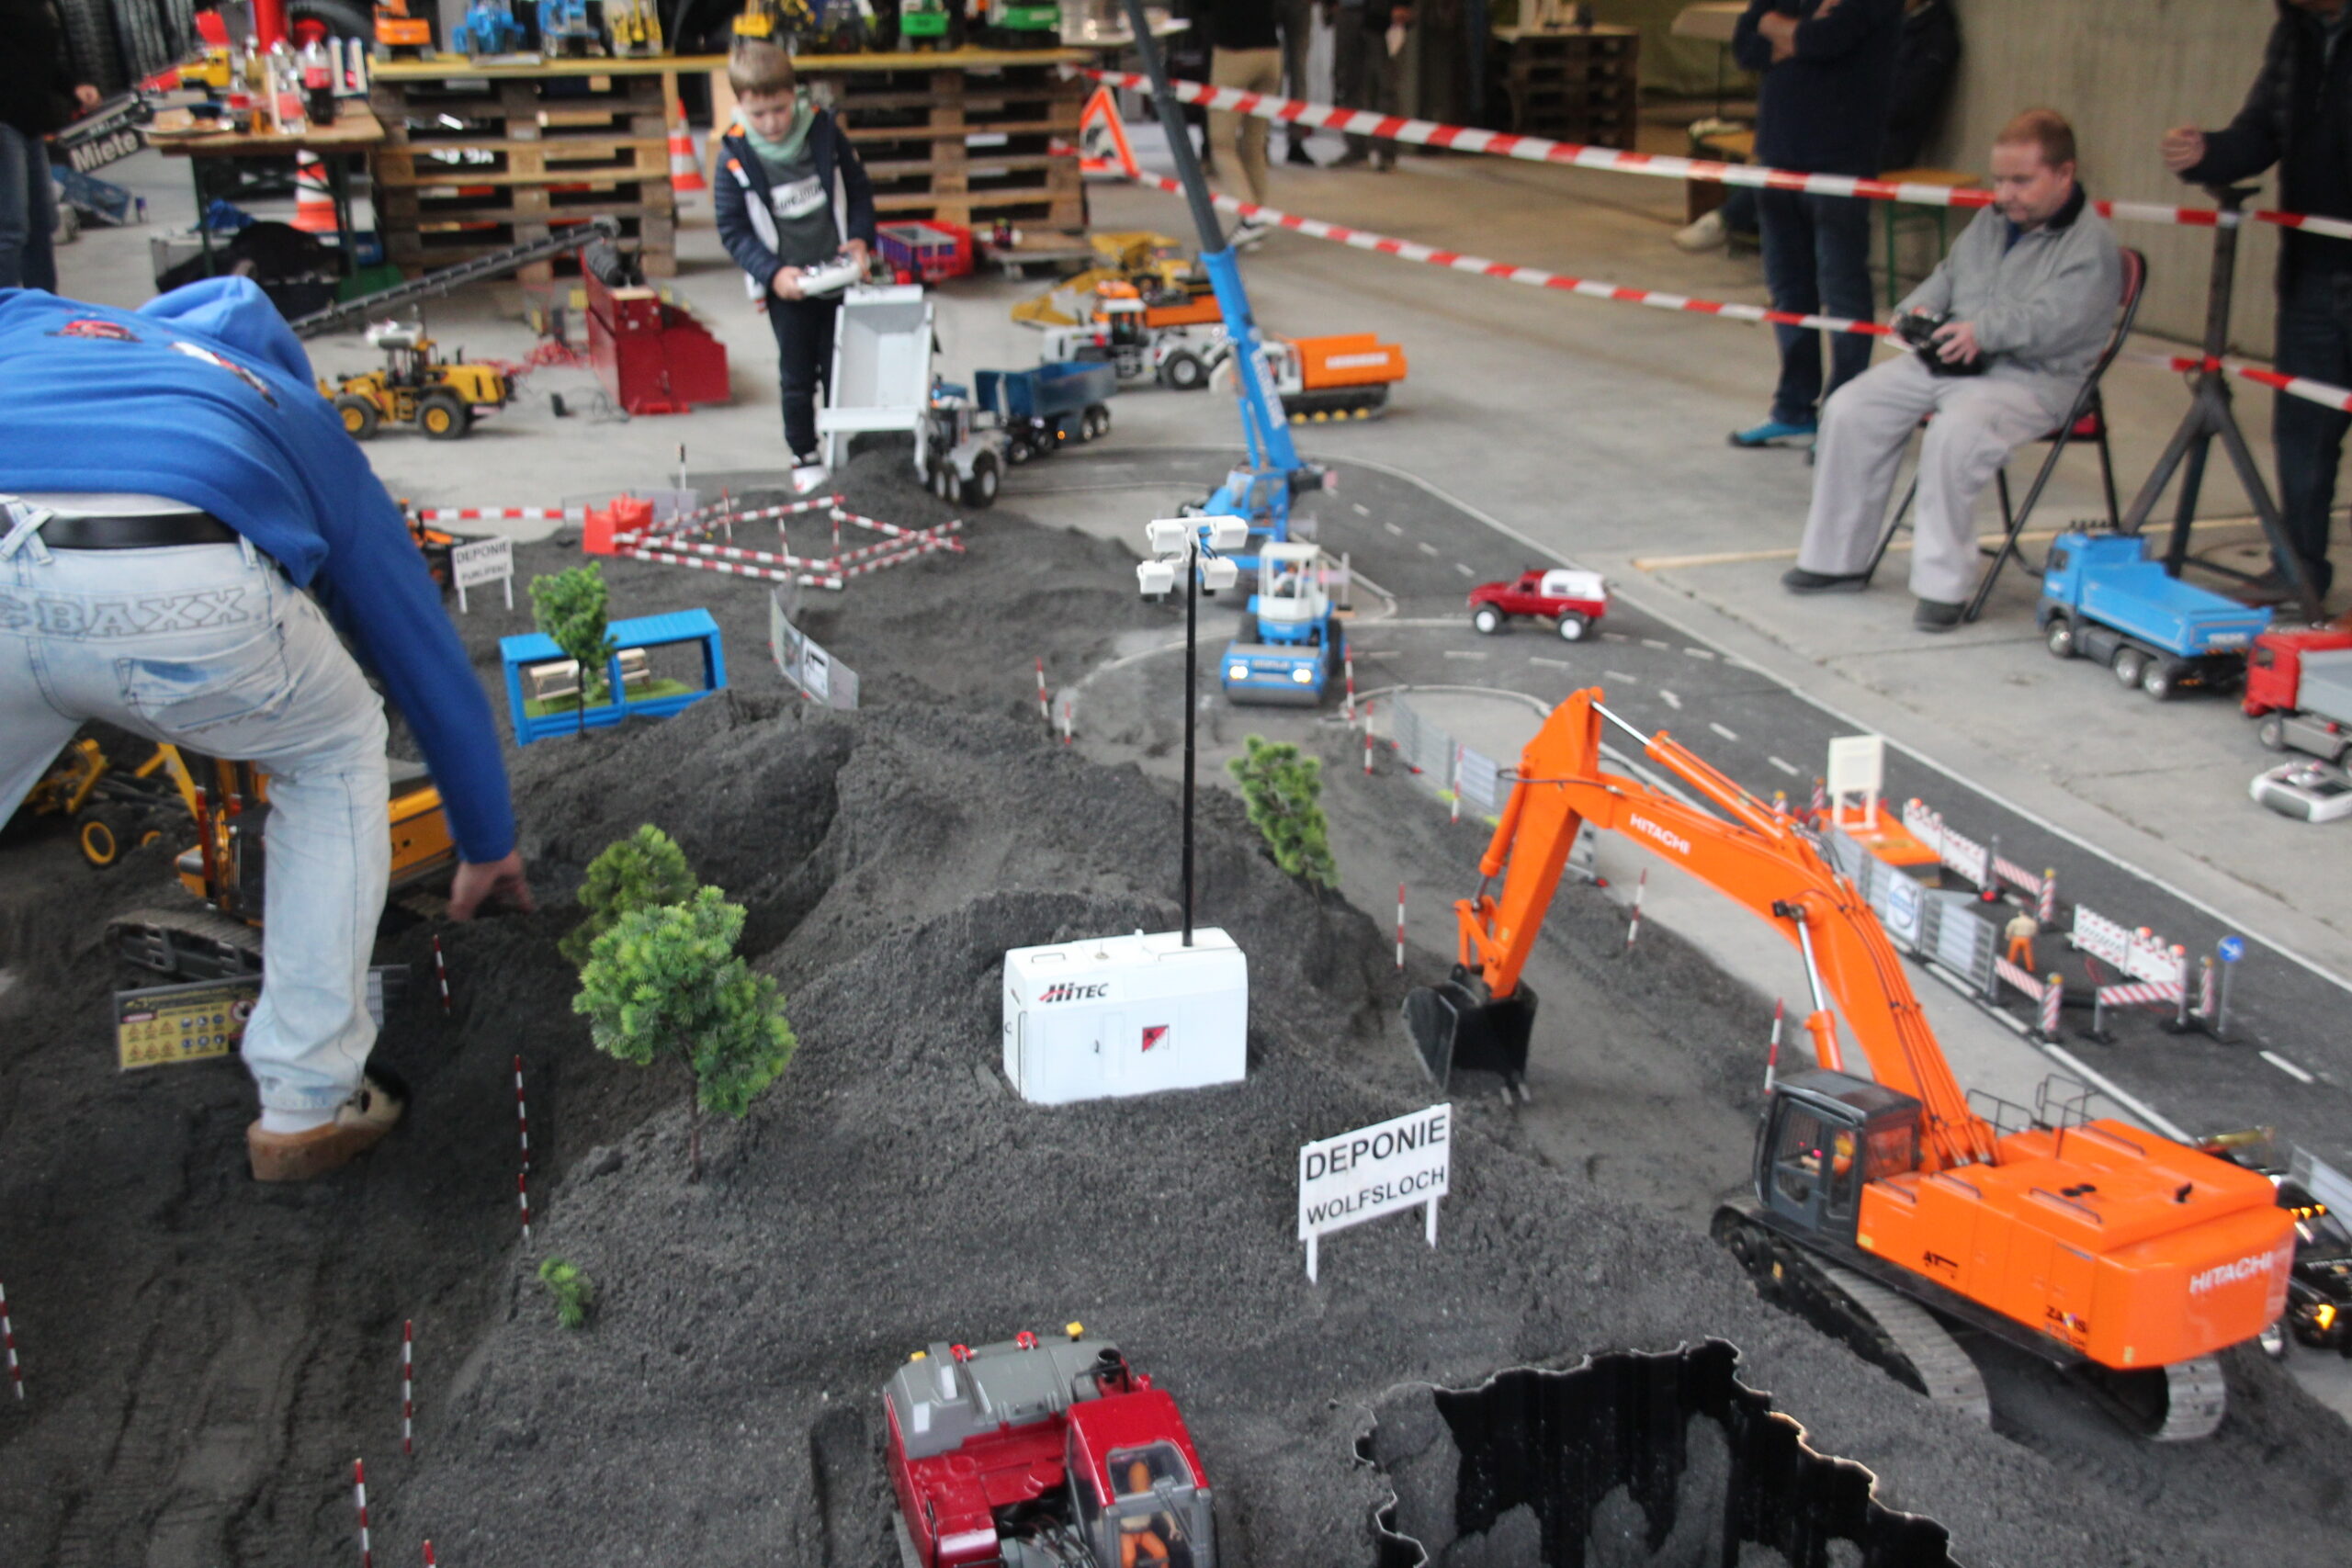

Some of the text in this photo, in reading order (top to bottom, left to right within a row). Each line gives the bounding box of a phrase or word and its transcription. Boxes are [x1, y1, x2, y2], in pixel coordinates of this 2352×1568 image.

[70, 130, 138, 173] Miete
[456, 540, 508, 563] DEPONIE
[35, 587, 248, 637] BAXX
[1630, 813, 1690, 855] HITACHI
[1306, 1114, 1446, 1181] DEPONIE
[1307, 1166, 1445, 1224] WOLFSLOCH
[2189, 1251, 2273, 1294] HITACHI
